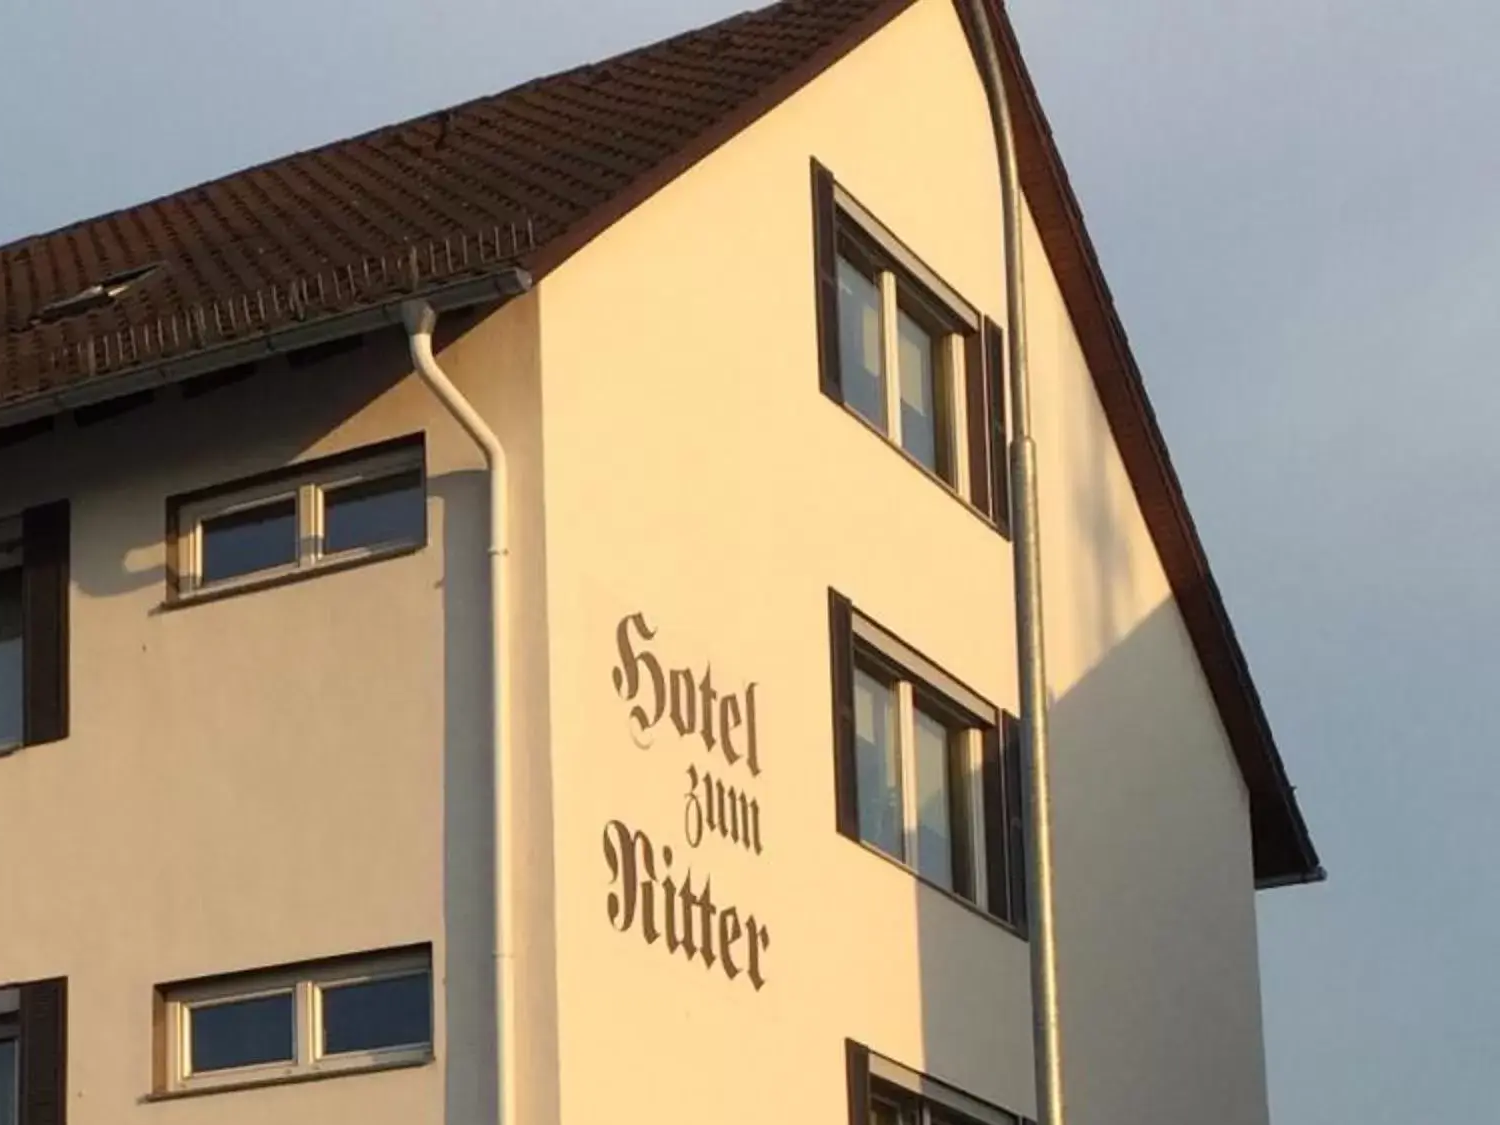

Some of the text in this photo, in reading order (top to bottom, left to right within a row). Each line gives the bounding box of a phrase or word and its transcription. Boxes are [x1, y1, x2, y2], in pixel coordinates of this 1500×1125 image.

[612, 612, 761, 778] Hotel
[684, 764, 763, 857] zum
[603, 819, 770, 992] Ritter
